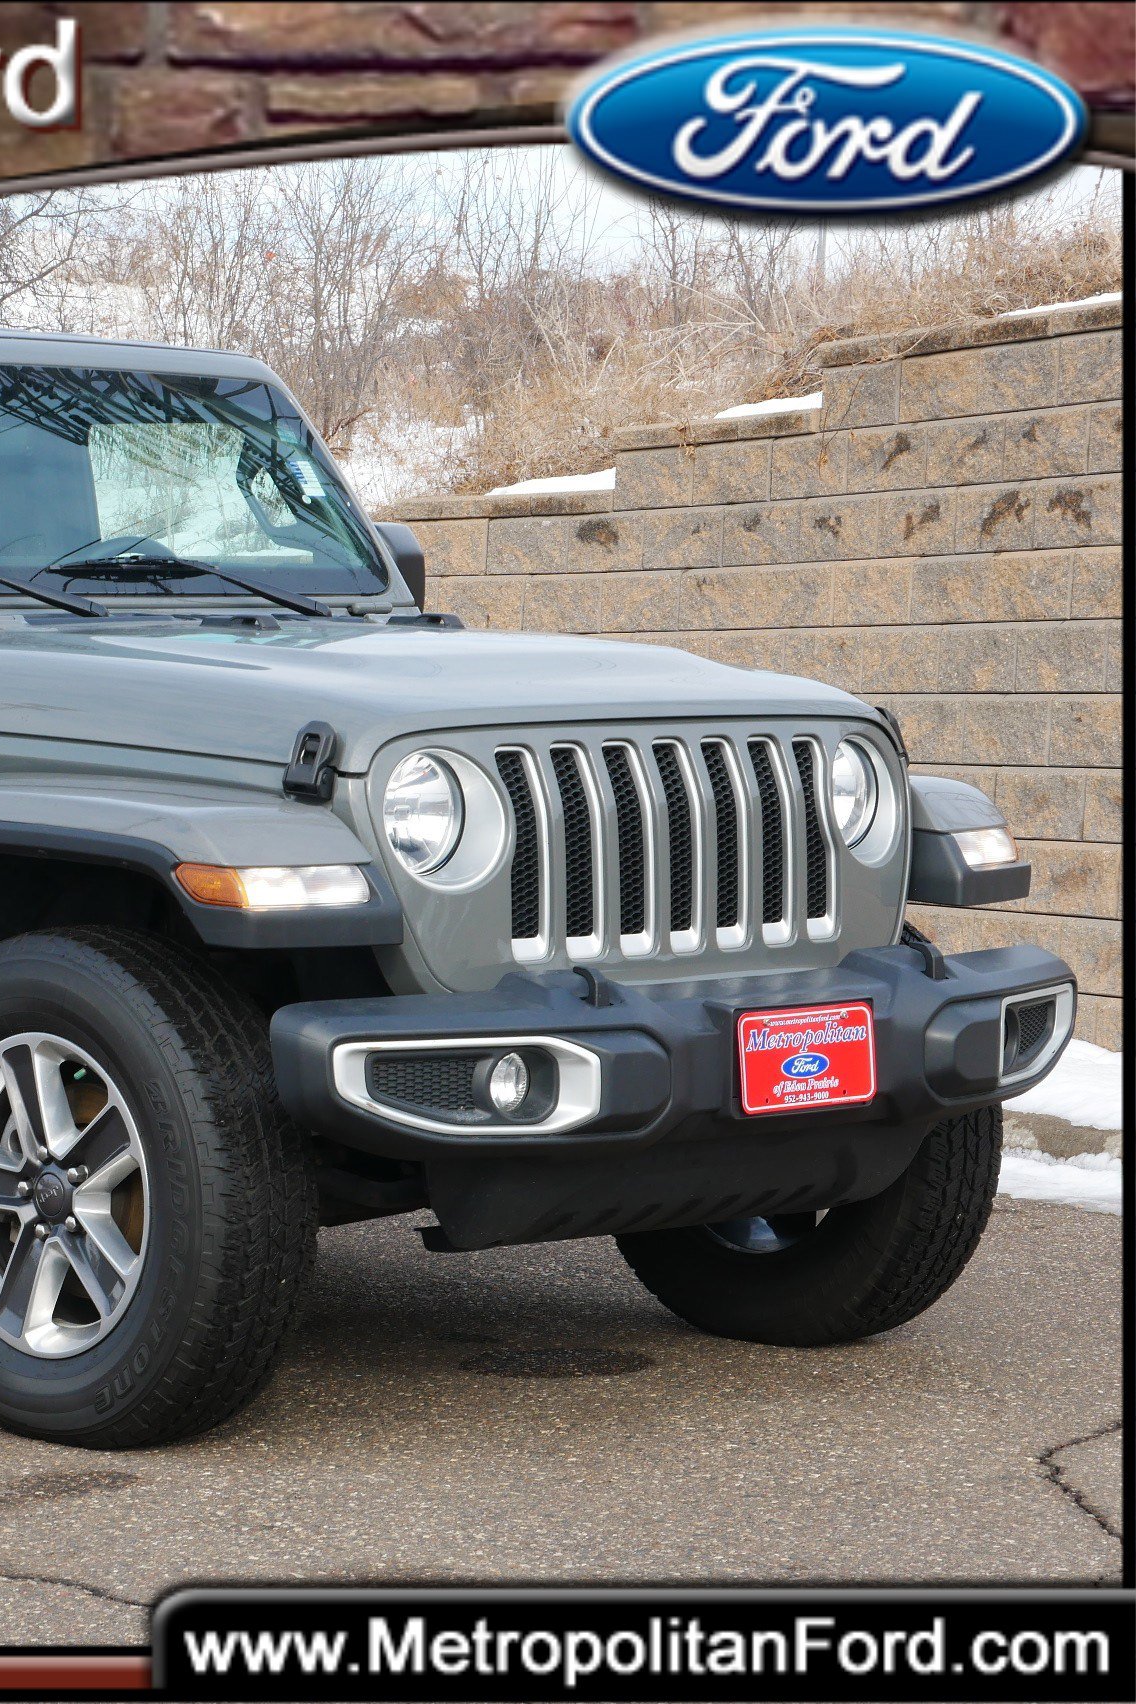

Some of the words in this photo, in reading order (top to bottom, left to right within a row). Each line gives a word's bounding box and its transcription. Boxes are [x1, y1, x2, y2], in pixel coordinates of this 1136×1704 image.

[745, 1021, 867, 1054] Metropolitan
[791, 1056, 820, 1074] Ford
[772, 1081, 784, 1097] of
[784, 1079, 807, 1093] Eden
[807, 1076, 840, 1091] Prairie
[784, 1090, 830, 1104] 952-943-9000
